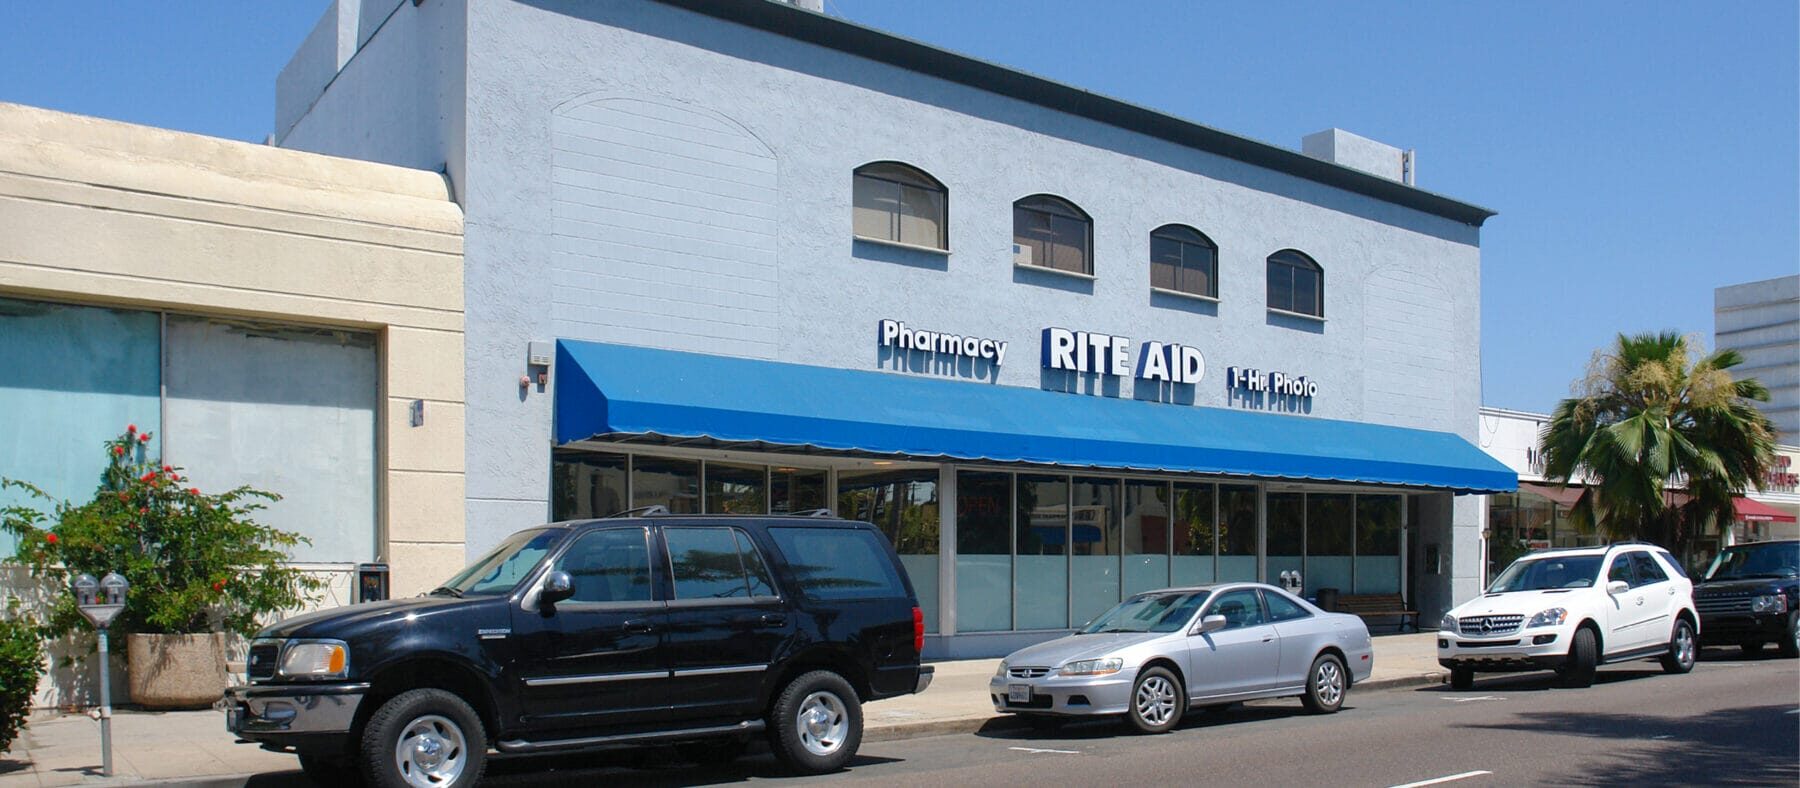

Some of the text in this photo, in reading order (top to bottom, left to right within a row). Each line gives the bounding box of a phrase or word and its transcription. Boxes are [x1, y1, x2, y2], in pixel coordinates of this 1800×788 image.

[880, 319, 1008, 366] Pharmacy
[1045, 327, 1206, 384] RITE AID
[1228, 366, 1319, 397] 1-Hr. Photo
[957, 495, 999, 515] OPEN
